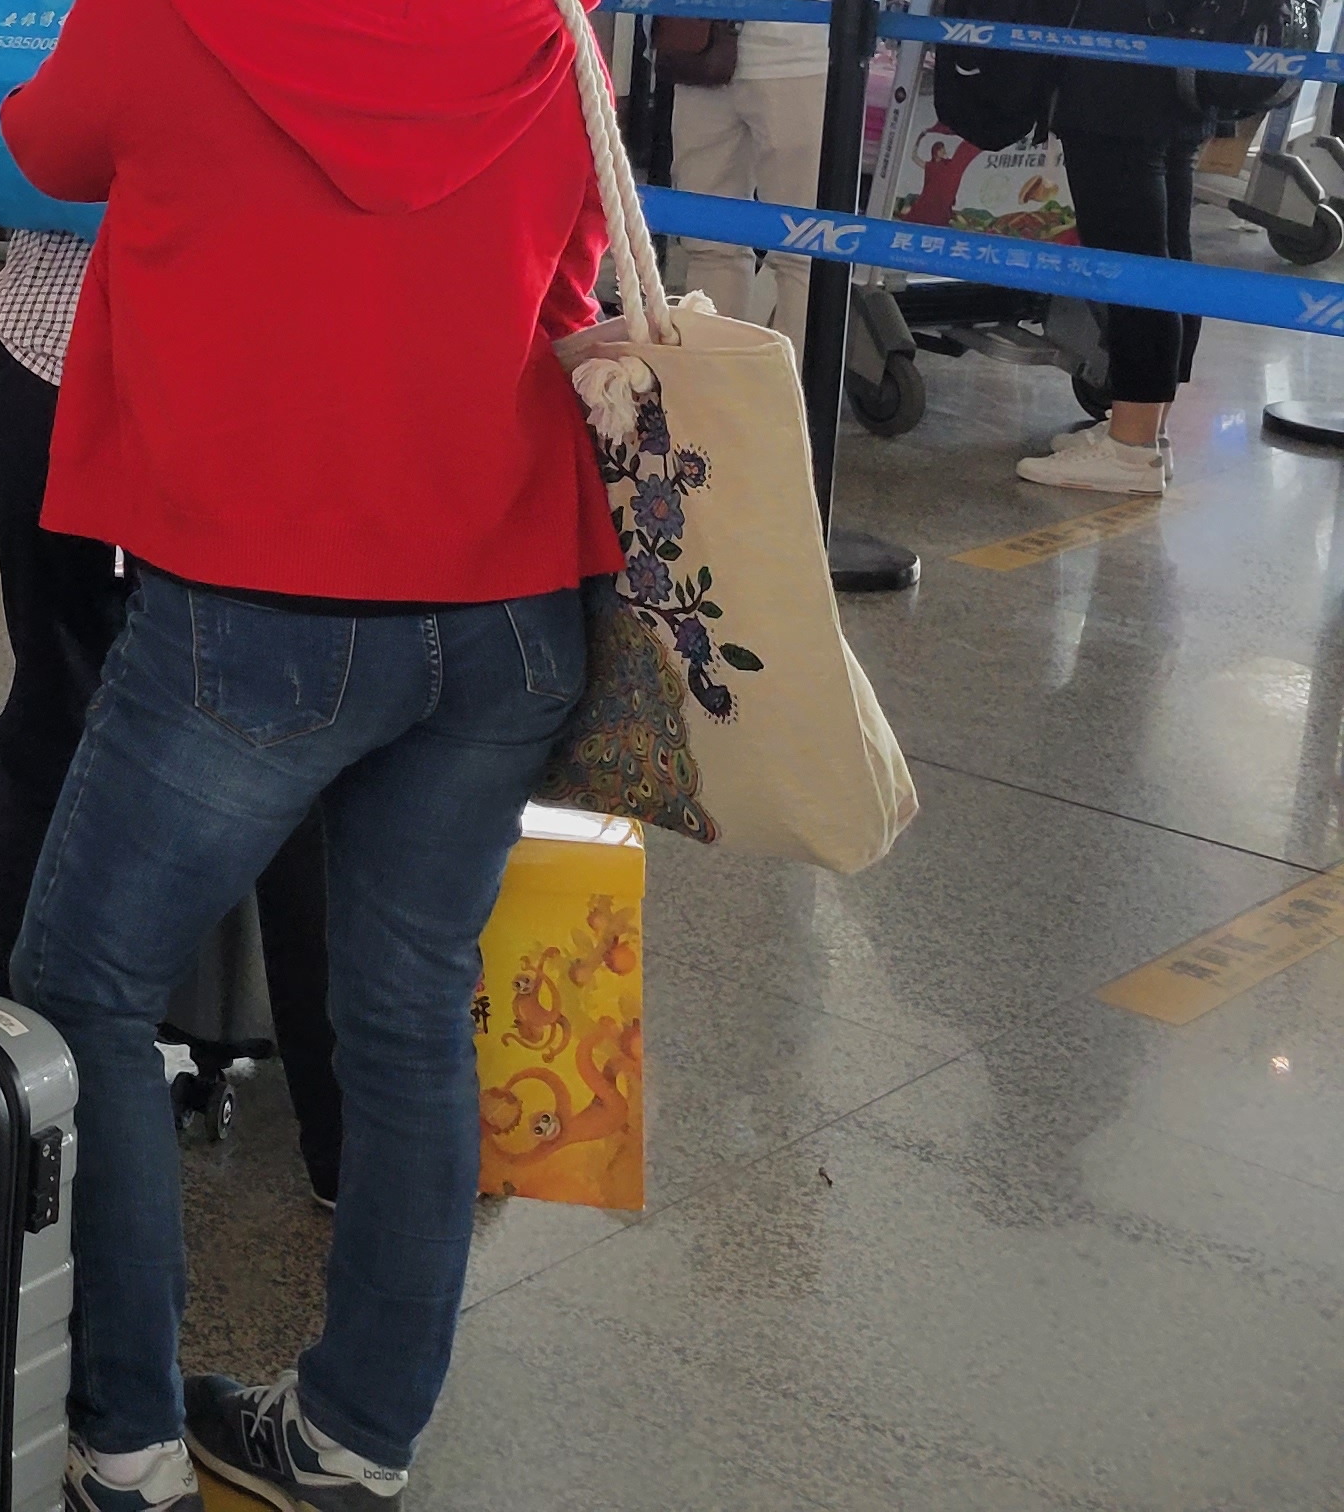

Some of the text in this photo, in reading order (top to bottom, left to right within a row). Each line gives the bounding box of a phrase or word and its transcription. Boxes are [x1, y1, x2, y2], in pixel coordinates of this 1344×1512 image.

[890, 232, 1123, 279] 昆明长水国际机场
